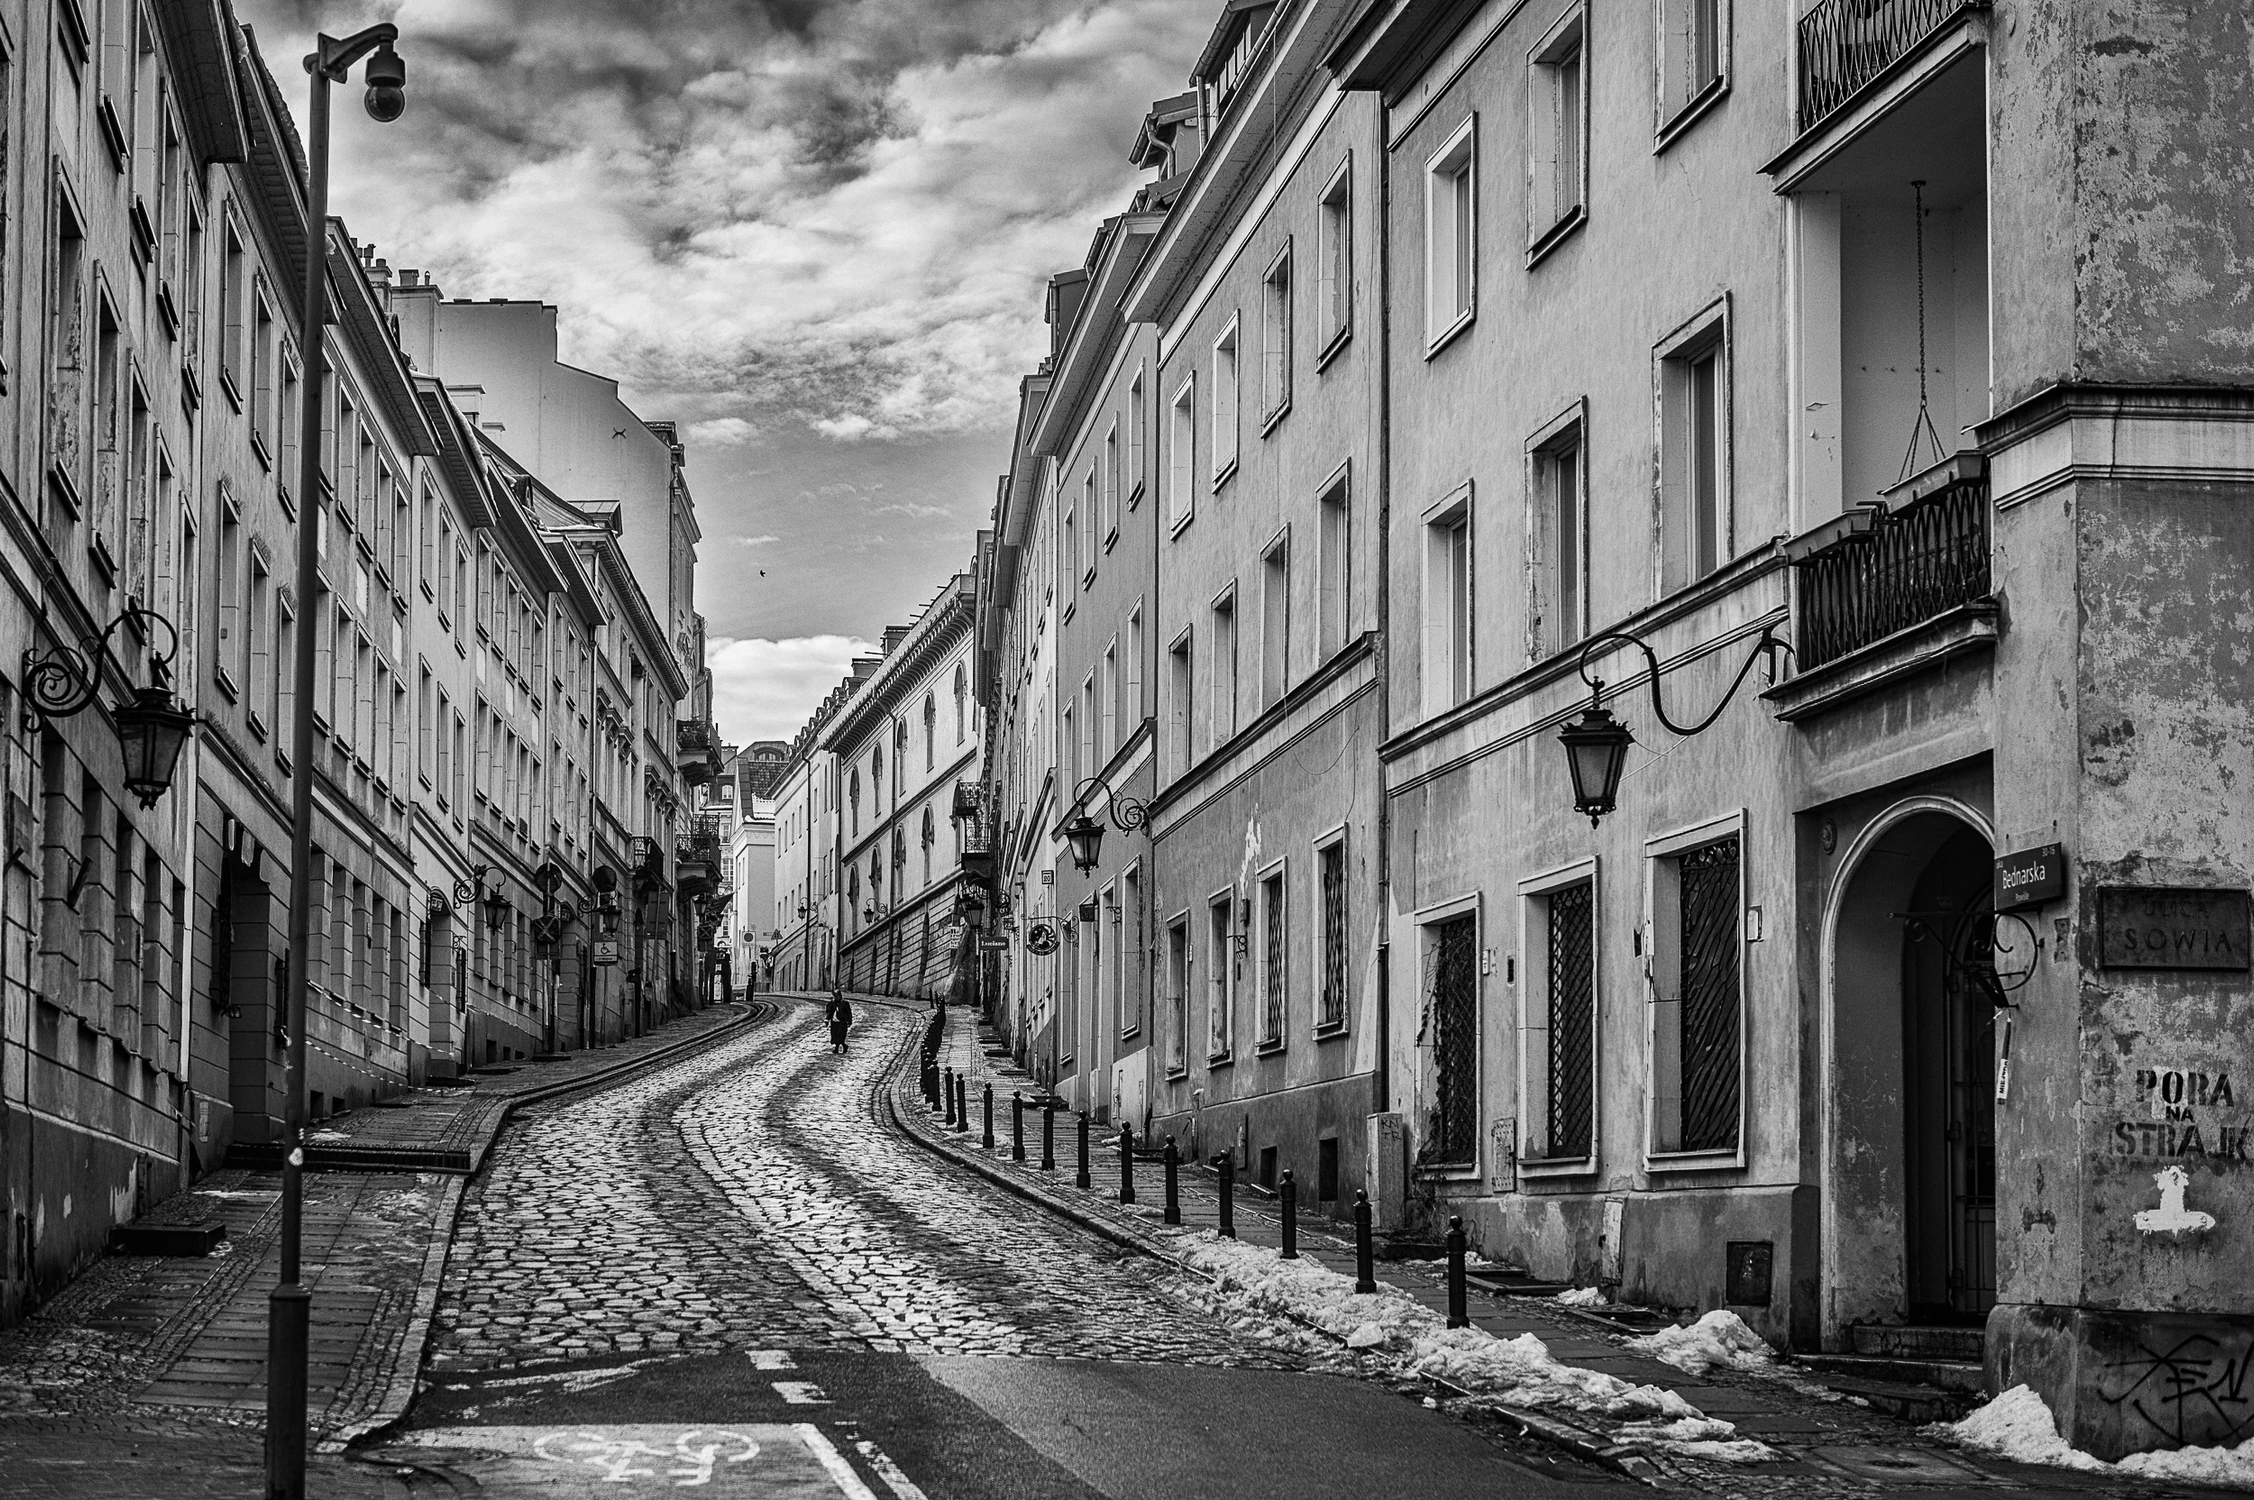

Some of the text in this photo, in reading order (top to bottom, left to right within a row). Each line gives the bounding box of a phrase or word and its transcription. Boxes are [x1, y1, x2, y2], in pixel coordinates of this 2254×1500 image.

[2003, 861, 2045, 889] Bednarska
[2144, 900, 2209, 918] ULICA
[2125, 928, 2232, 952] SOWIA
[2135, 1069, 2235, 1107] PORA
[2165, 1105, 2195, 1123] NA
[2115, 1121, 2250, 1161] STRAJK
